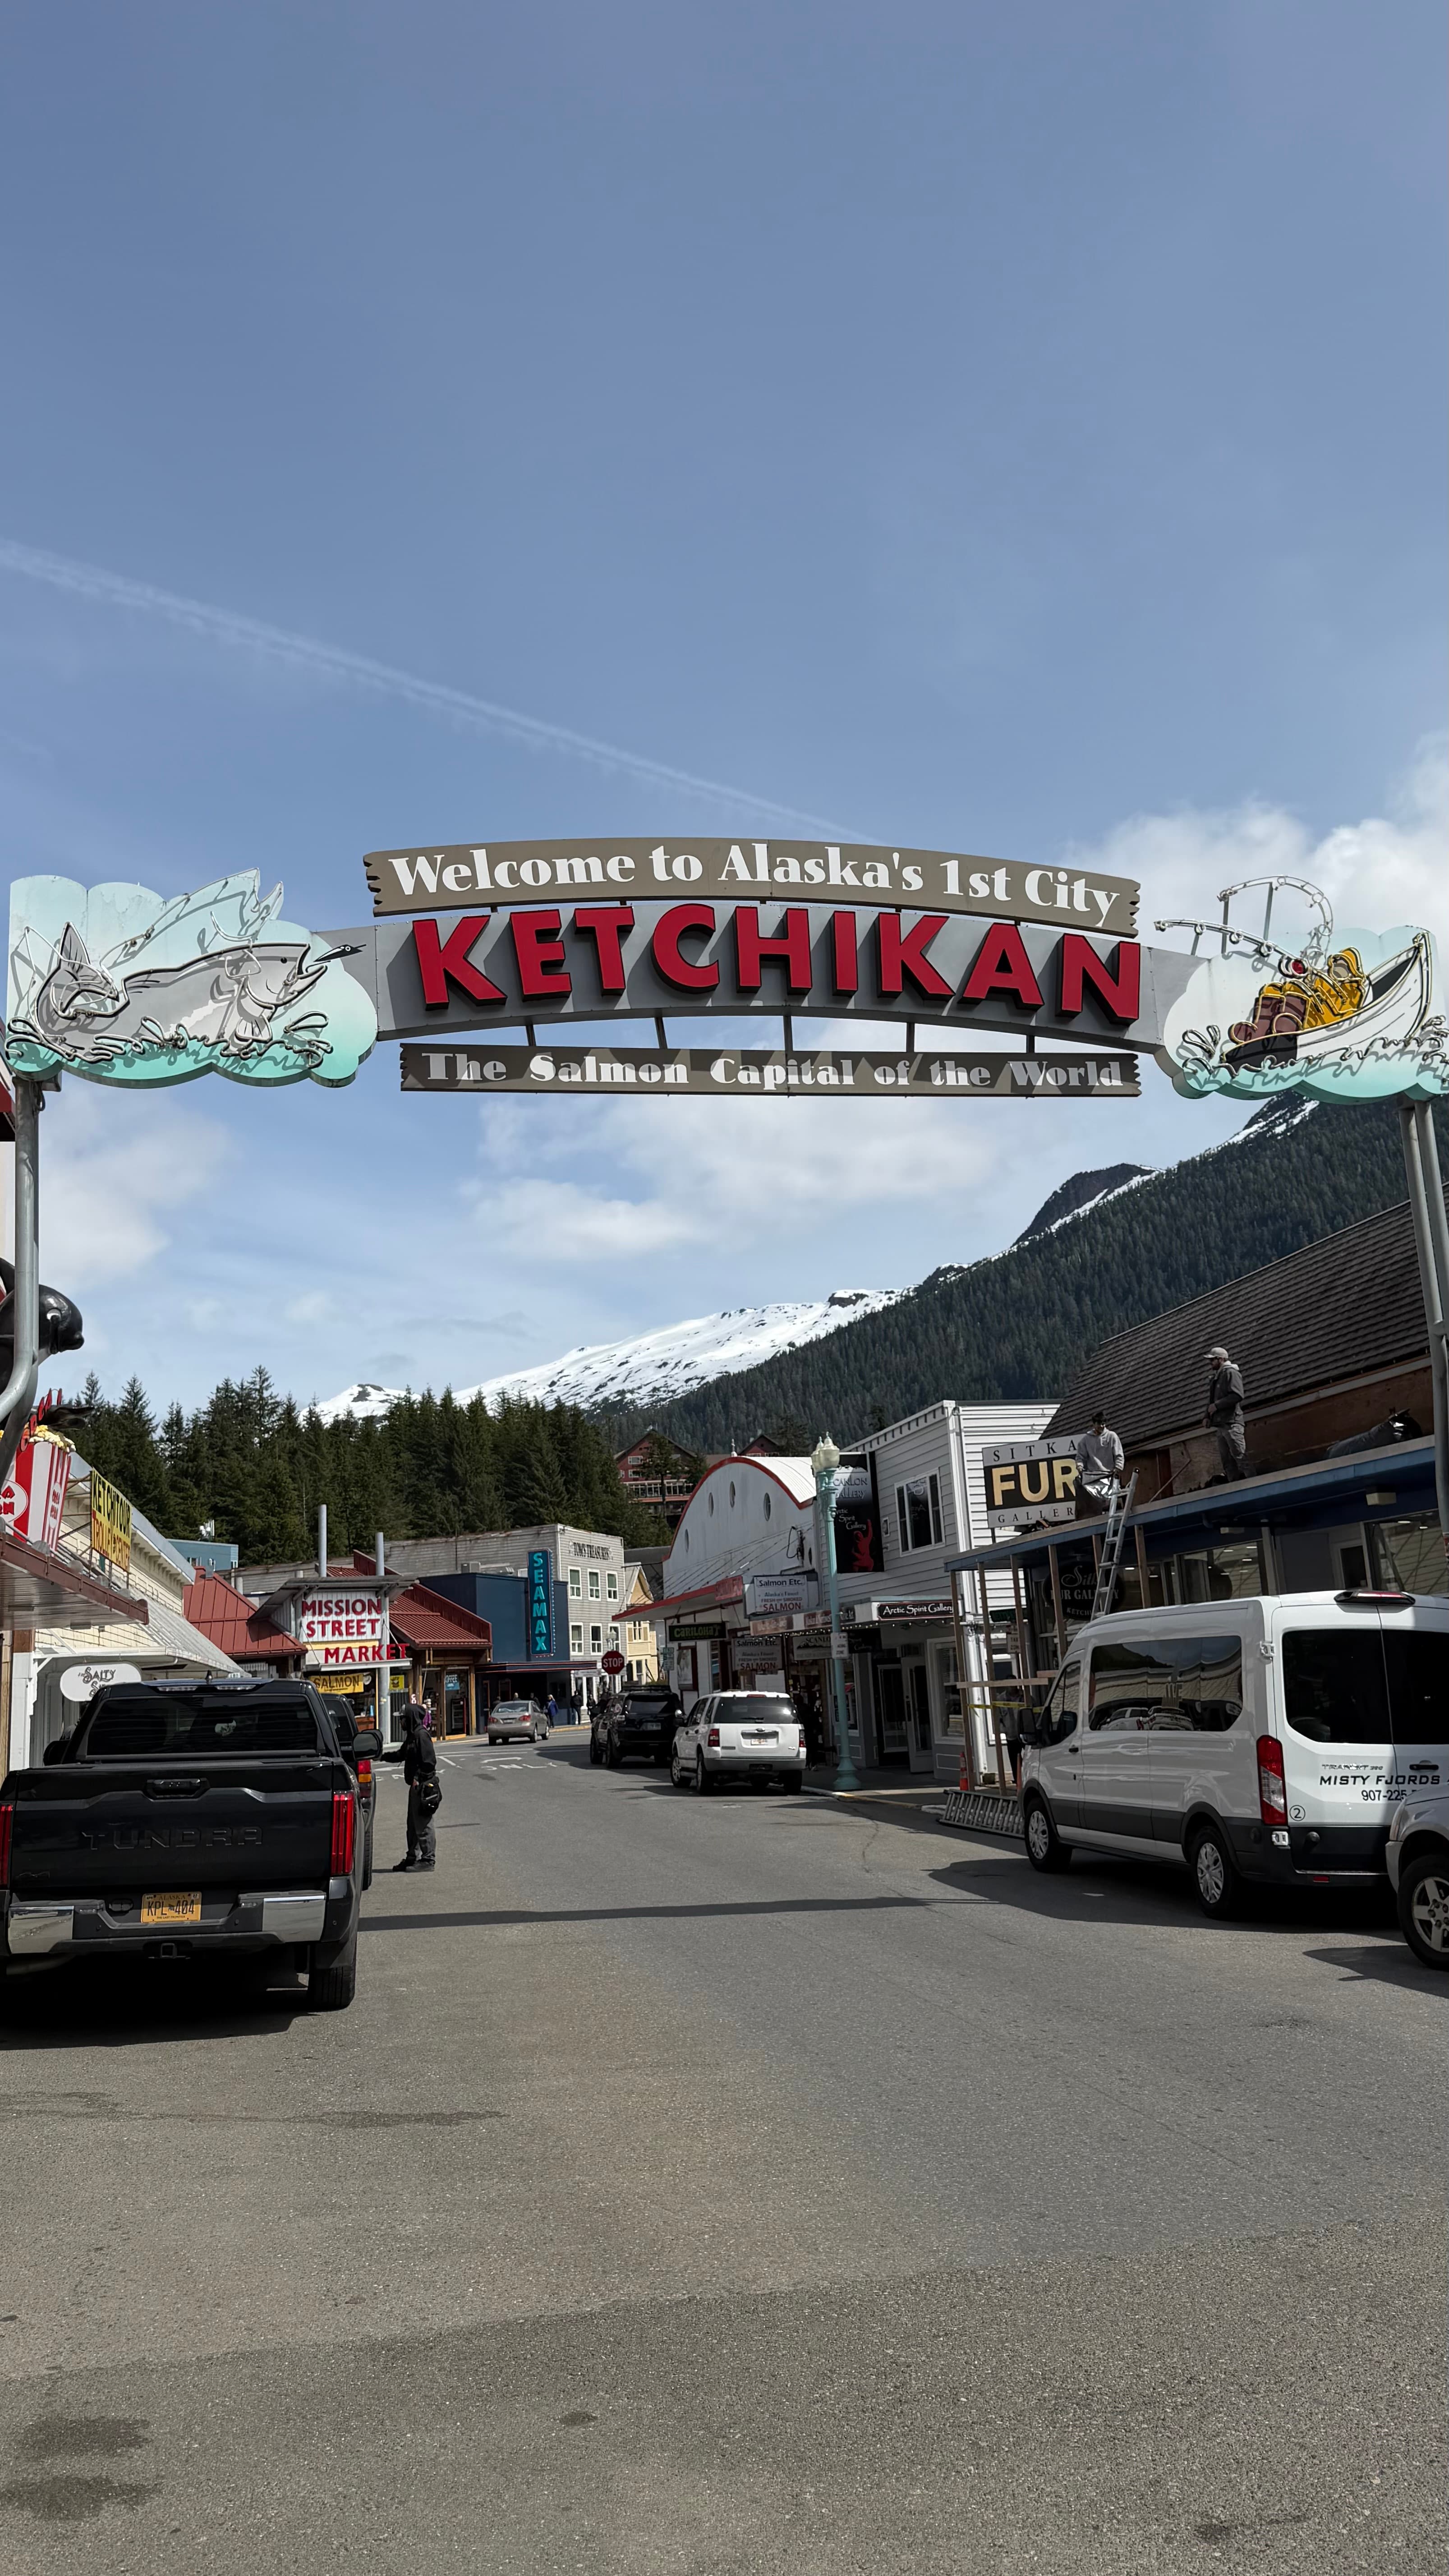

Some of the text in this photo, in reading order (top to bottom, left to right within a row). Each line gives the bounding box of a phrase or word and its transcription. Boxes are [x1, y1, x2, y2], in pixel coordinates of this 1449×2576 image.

[388, 843, 1120, 927] Welcome to Alaska's 1st City
[412, 903, 1141, 1025] KETCHIKAN
[422, 1053, 1123, 1090] The Salmon Capital of the World
[993, 1439, 1077, 1462] SITKA
[833, 1475, 868, 1486] CANLON
[92, 1469, 130, 1538] KETCHITOUR
[998, 1506, 1075, 1523] GALLER
[302, 1598, 382, 1617] MISSION
[533, 1552, 547, 1651] SEAMAX
[764, 1602, 801, 1611] SALMON
[883, 1603, 953, 1615] Arctic Spirit Gallery
[306, 1618, 380, 1638] STREET
[324, 1643, 410, 1664] MARKET
[603, 1658, 623, 1668] STOP
[741, 1662, 776, 1670] SALMON
[83, 1667, 116, 1684] SALTY
[314, 1675, 359, 1689] SALMON
[1320, 1775, 1371, 1785] MISTY
[1375, 1775, 1440, 1785] FJORDS
[81, 1826, 264, 1850] TUNDRA
[147, 1900, 195, 1916] KPL 404
